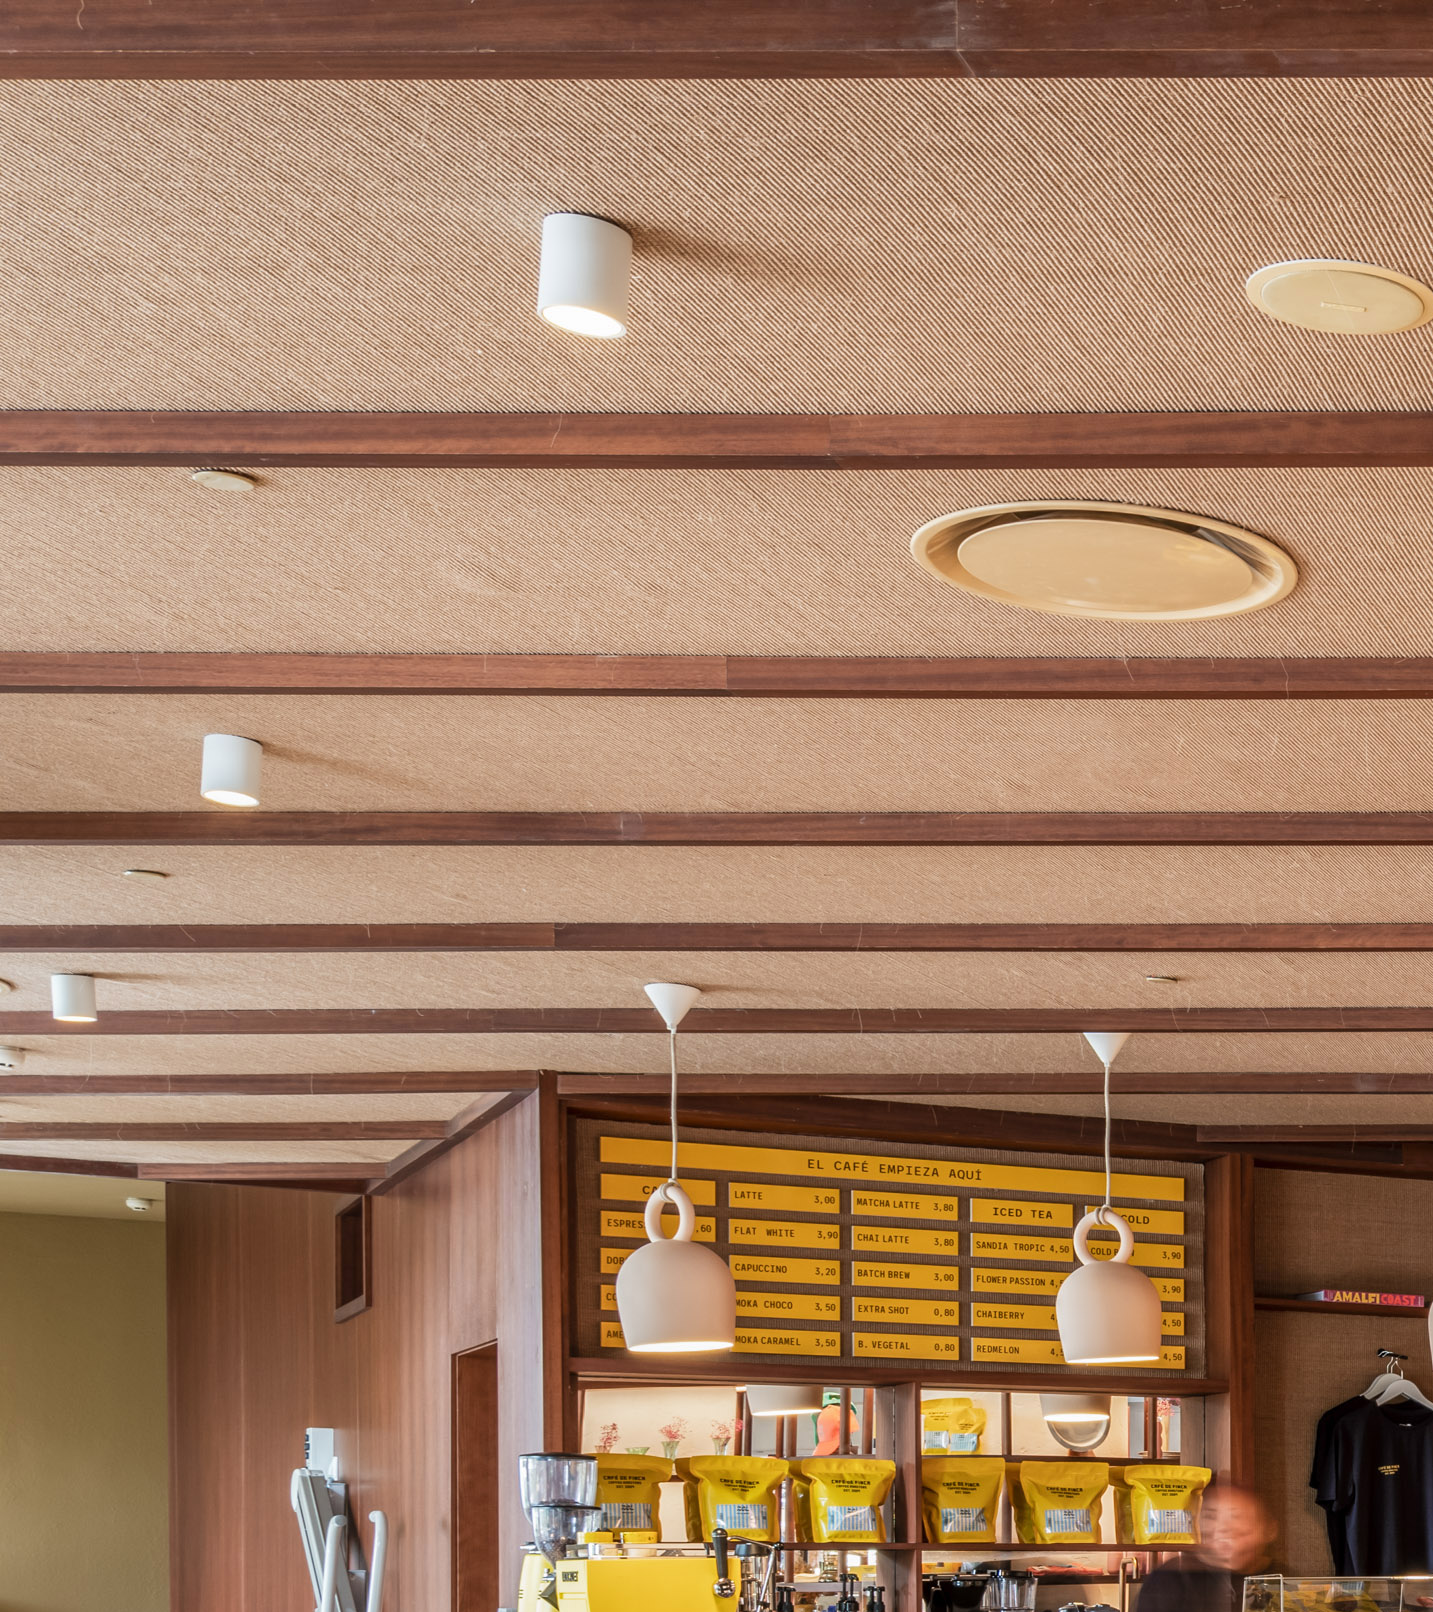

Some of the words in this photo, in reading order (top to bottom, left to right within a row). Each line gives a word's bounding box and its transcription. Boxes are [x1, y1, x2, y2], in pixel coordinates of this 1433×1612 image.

[808, 1159, 824, 1169] EL
[834, 1161, 869, 1172] CAFÉ
[879, 1164, 939, 1177] EMPIEZA
[949, 1169, 982, 1180] AQUÍ
[734, 1191, 763, 1200] LATTE
[814, 1195, 835, 1205] 3,00
[857, 1198, 890, 1207] MATCHA
[893, 1201, 920, 1209] LATTE
[933, 1203, 953, 1212] 3,80
[993, 1207, 1022, 1217] ICED
[1031, 1210, 1053, 1219] TEA
[696, 1225, 711, 1234] ,60
[734, 1227, 757, 1236] FLAT
[766, 1229, 795, 1238] WHITE
[817, 1231, 838, 1240] 3,90
[857, 1233, 879, 1242] CHAI
[882, 1235, 909, 1244] LATTE
[934, 1238, 954, 1247] 3,80
[976, 1241, 1008, 1250] SANDIA
[1014, 1243, 1046, 1252] TROPIC
[1049, 1245, 1070, 1254] 4,50
[1162, 1251, 1181, 1260] 3,90
[735, 1264, 787, 1273] CAPUCCINO
[815, 1267, 836, 1276] 3,20
[857, 1269, 885, 1278] BATCH
[888, 1270, 910, 1279] BREW
[934, 1273, 954, 1282] 3,00
[976, 1275, 1007, 1284] FLOWER
[1009, 1277, 1046, 1286] PASSION
[1162, 1286, 1181, 1294] 3,90
[1333, 1291, 1380, 1305] AMALFI
[1381, 1294, 1416, 1305] COAST
[735, 1299, 758, 1308] MOKA
[764, 1301, 793, 1309] CHOCO
[815, 1303, 836, 1312] 3,50
[858, 1305, 885, 1313] EXTRA
[888, 1306, 909, 1315] SHOT
[934, 1308, 954, 1317] 0,80
[977, 1310, 1025, 1320] CHAIBERRY
[1163, 1319, 1181, 1328] 4,50
[735, 1335, 758, 1344] MOKA
[761, 1337, 800, 1346] CARAMEL
[815, 1338, 836, 1347] 3,50
[858, 1340, 868, 1348] B.
[872, 1341, 910, 1350] VEGETAL
[934, 1343, 955, 1352] 0,80
[977, 1345, 1019, 1354] REDMELON
[1163, 1353, 1182, 1362] 4,50
